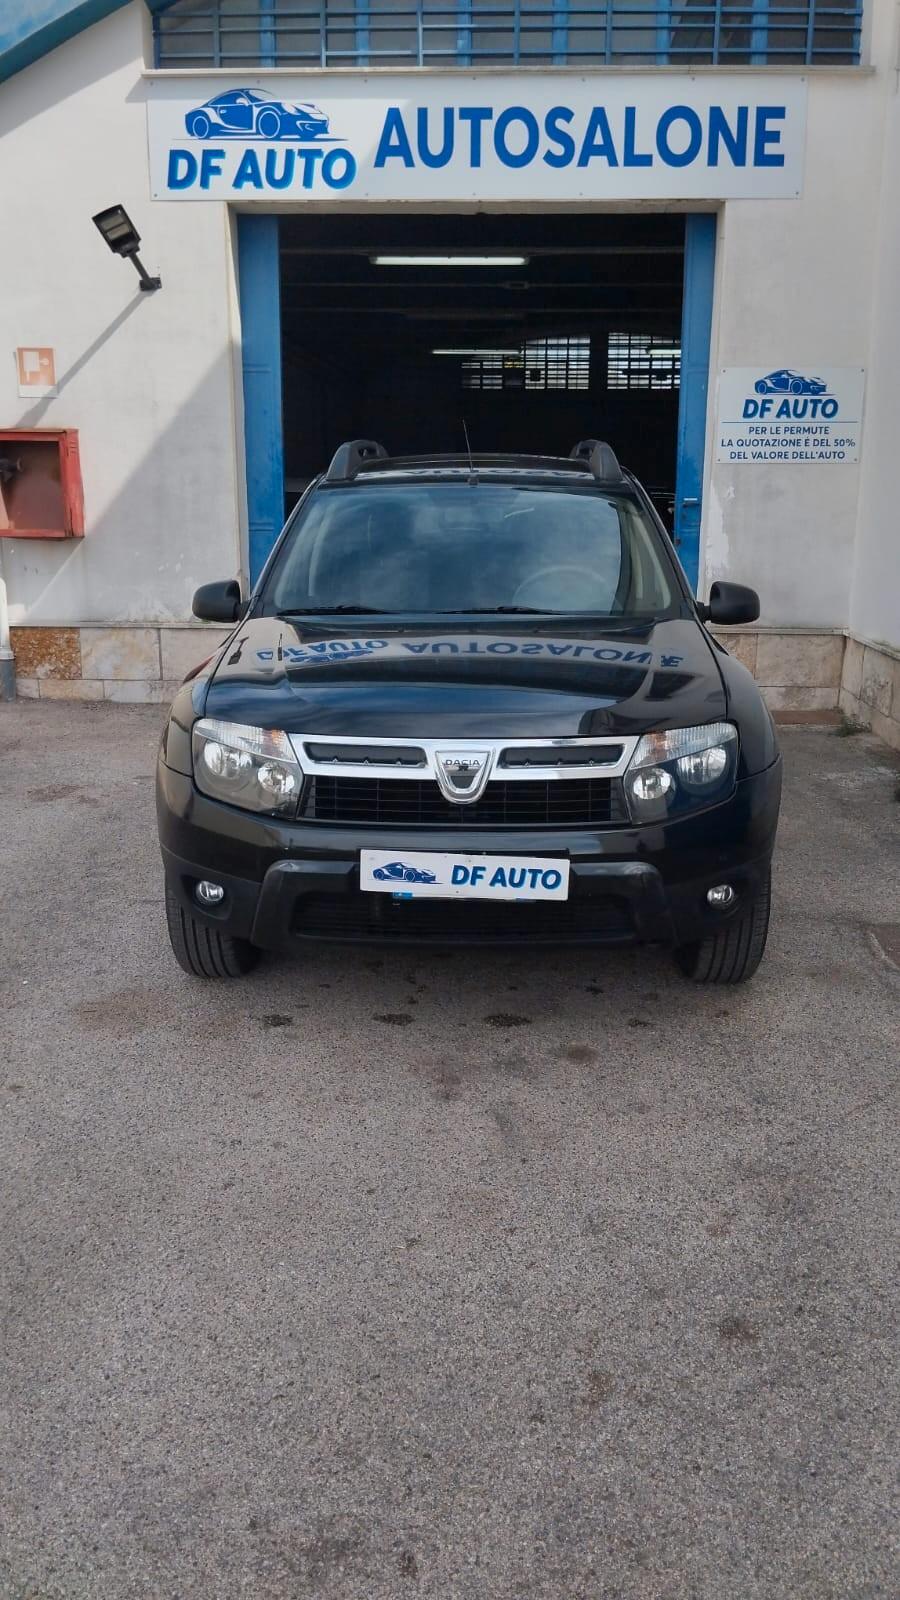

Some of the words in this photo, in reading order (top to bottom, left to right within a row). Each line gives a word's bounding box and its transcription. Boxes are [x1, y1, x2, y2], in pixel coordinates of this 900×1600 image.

[374, 105, 786, 169] AUTOSALONE
[167, 149, 226, 190] DF
[232, 148, 357, 190] AUTO
[742, 398, 774, 419] DF
[775, 398, 839, 419] AUTO
[748, 426, 767, 435] PER
[769, 426, 781, 435] LE
[783, 426, 830, 435] PERMUTE
[720, 438, 734, 447] LA
[736, 438, 802, 448] QUOTAZIONE
[812, 438, 831, 447] DEL
[833, 438, 856, 448] 50%
[729, 450, 748, 460] DEL
[751, 450, 789, 460] VALORE
[791, 450, 846, 460] DELL'AUTO
[451, 864, 487, 885] DF
[489, 867, 562, 890] AUTO
